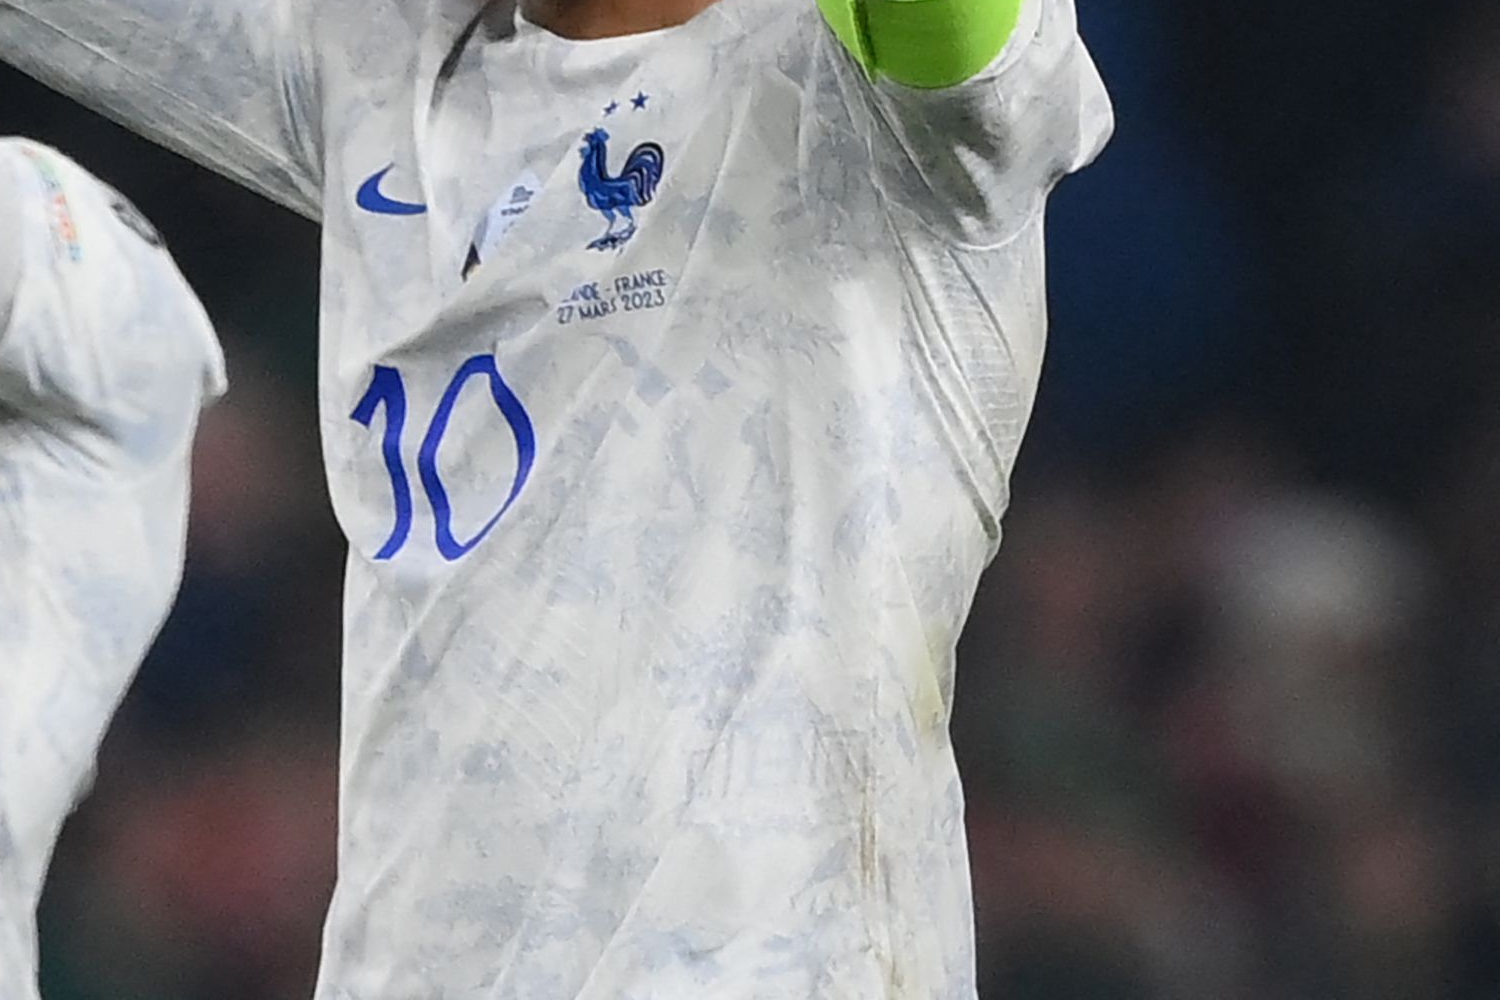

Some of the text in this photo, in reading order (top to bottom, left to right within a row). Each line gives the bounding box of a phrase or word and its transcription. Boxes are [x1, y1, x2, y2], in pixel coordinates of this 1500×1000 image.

[614, 269, 667, 295] FRANCE
[558, 288, 666, 325] 27 MARS 2023
[349, 354, 536, 561] 10
